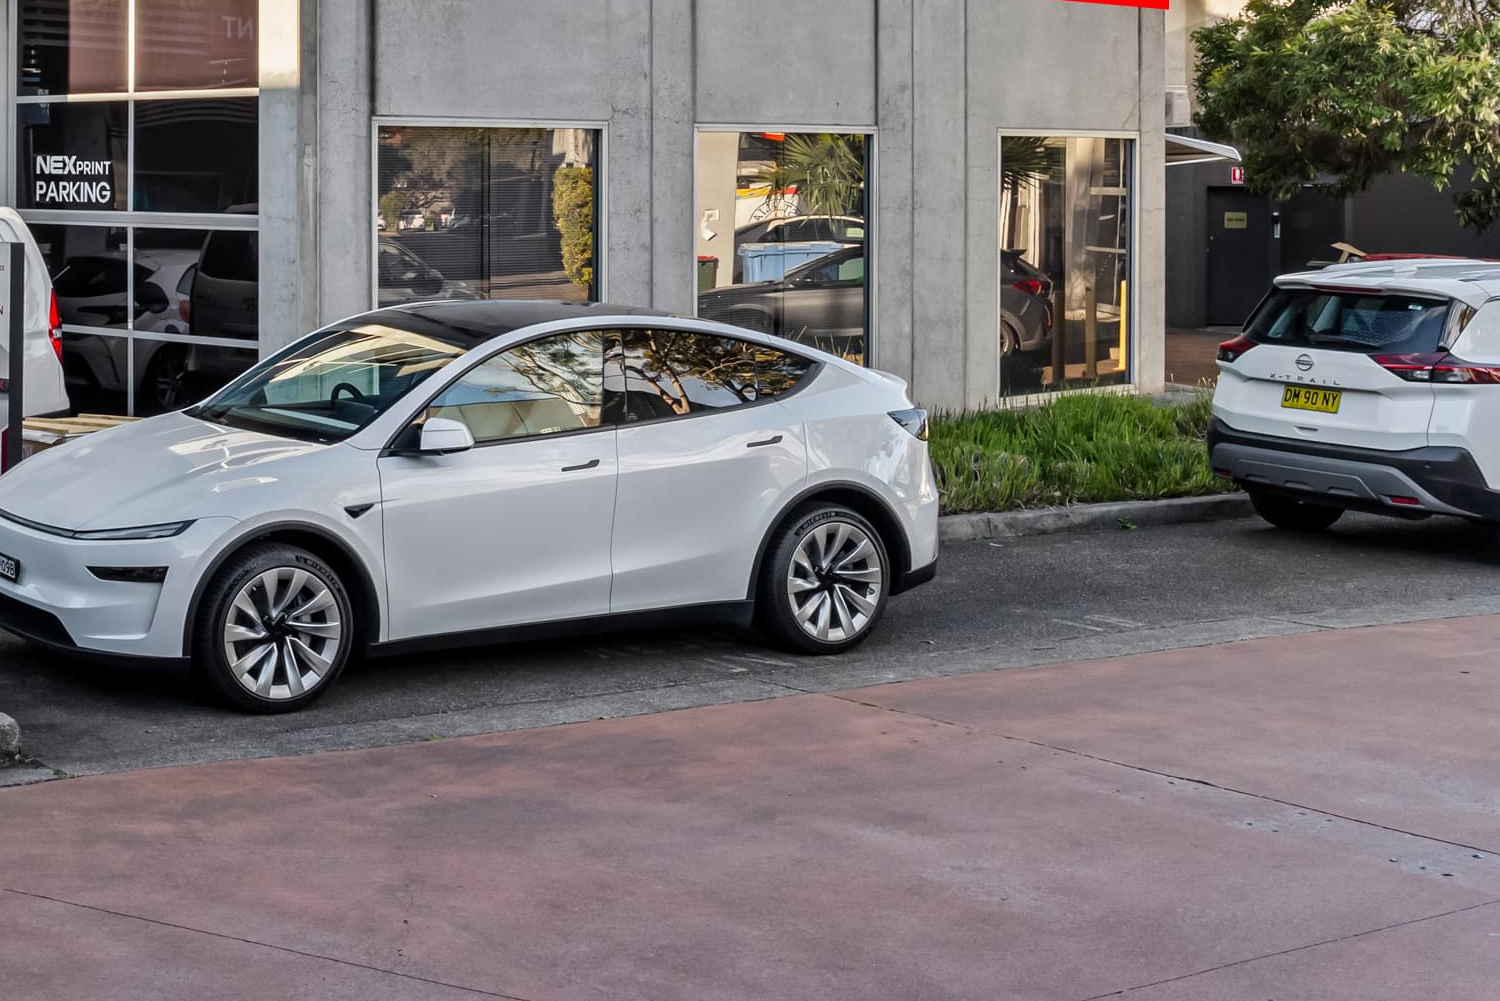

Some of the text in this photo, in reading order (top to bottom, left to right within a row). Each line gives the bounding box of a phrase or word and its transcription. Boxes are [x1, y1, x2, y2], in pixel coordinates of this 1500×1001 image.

[36, 181, 111, 203] PARKING
[1304, 390, 1319, 406] 90
[1321, 392, 1339, 408] NY
